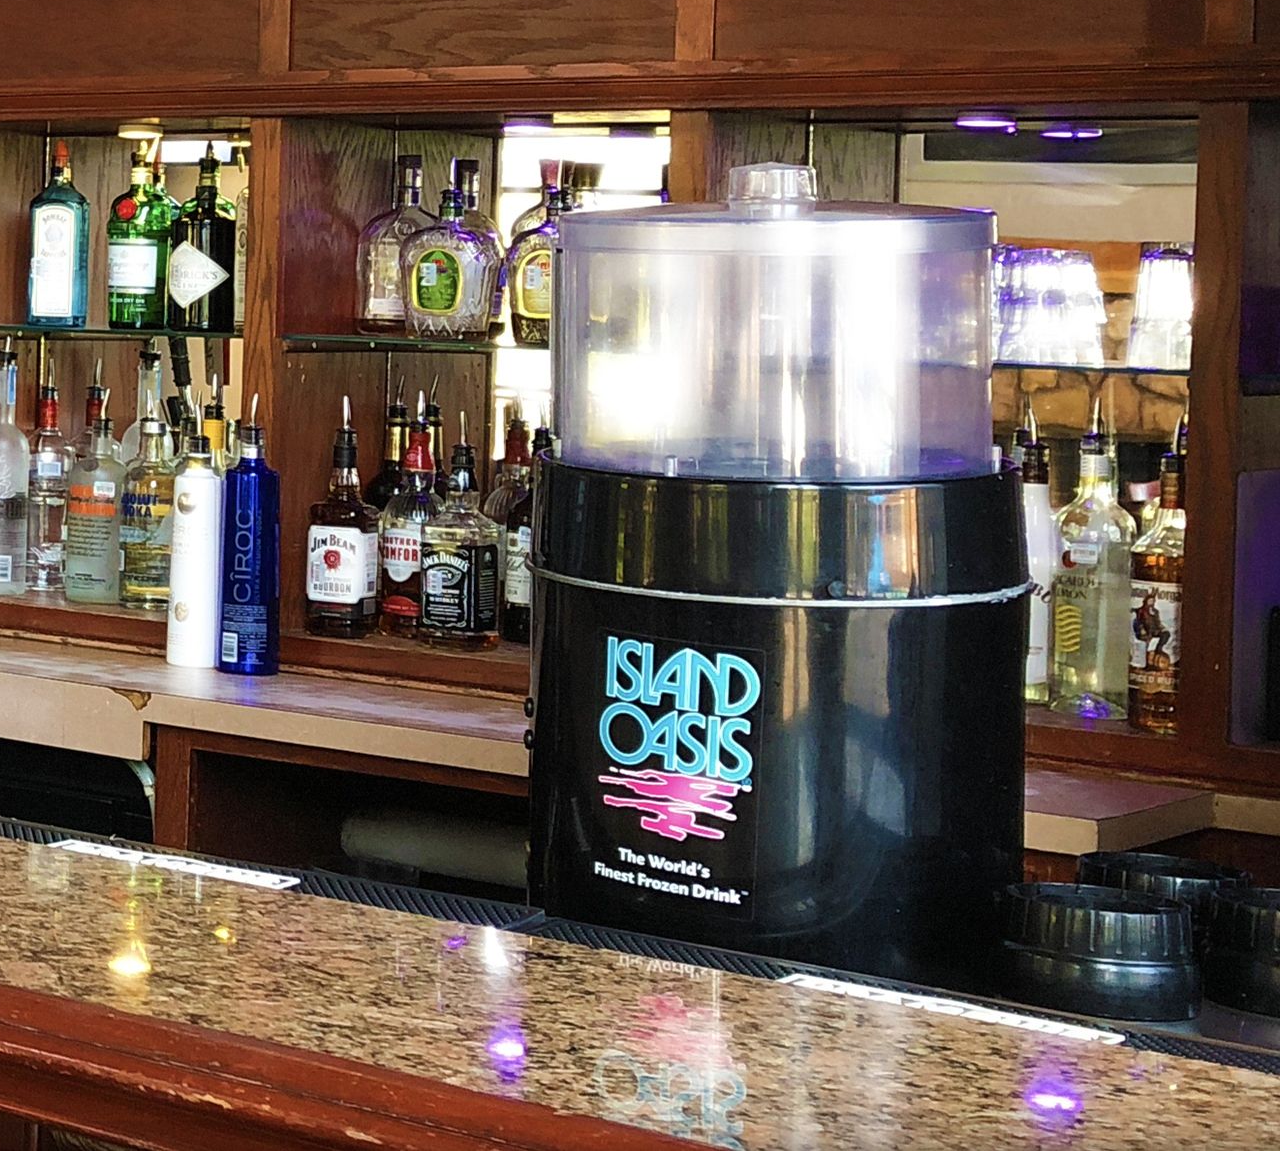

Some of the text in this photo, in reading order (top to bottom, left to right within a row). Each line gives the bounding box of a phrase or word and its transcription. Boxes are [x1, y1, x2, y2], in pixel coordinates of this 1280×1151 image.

[230, 509, 255, 603] CÎROC
[311, 533, 357, 556] JIM BEAM
[422, 550, 470, 572] JACK DANIEL'S
[606, 635, 761, 717] ISLAND
[1130, 673, 1154, 683] PICED
[599, 701, 753, 781] OASIS
[618, 847, 711, 879] The World's
[594, 861, 742, 905] Finest Frozen Drink
